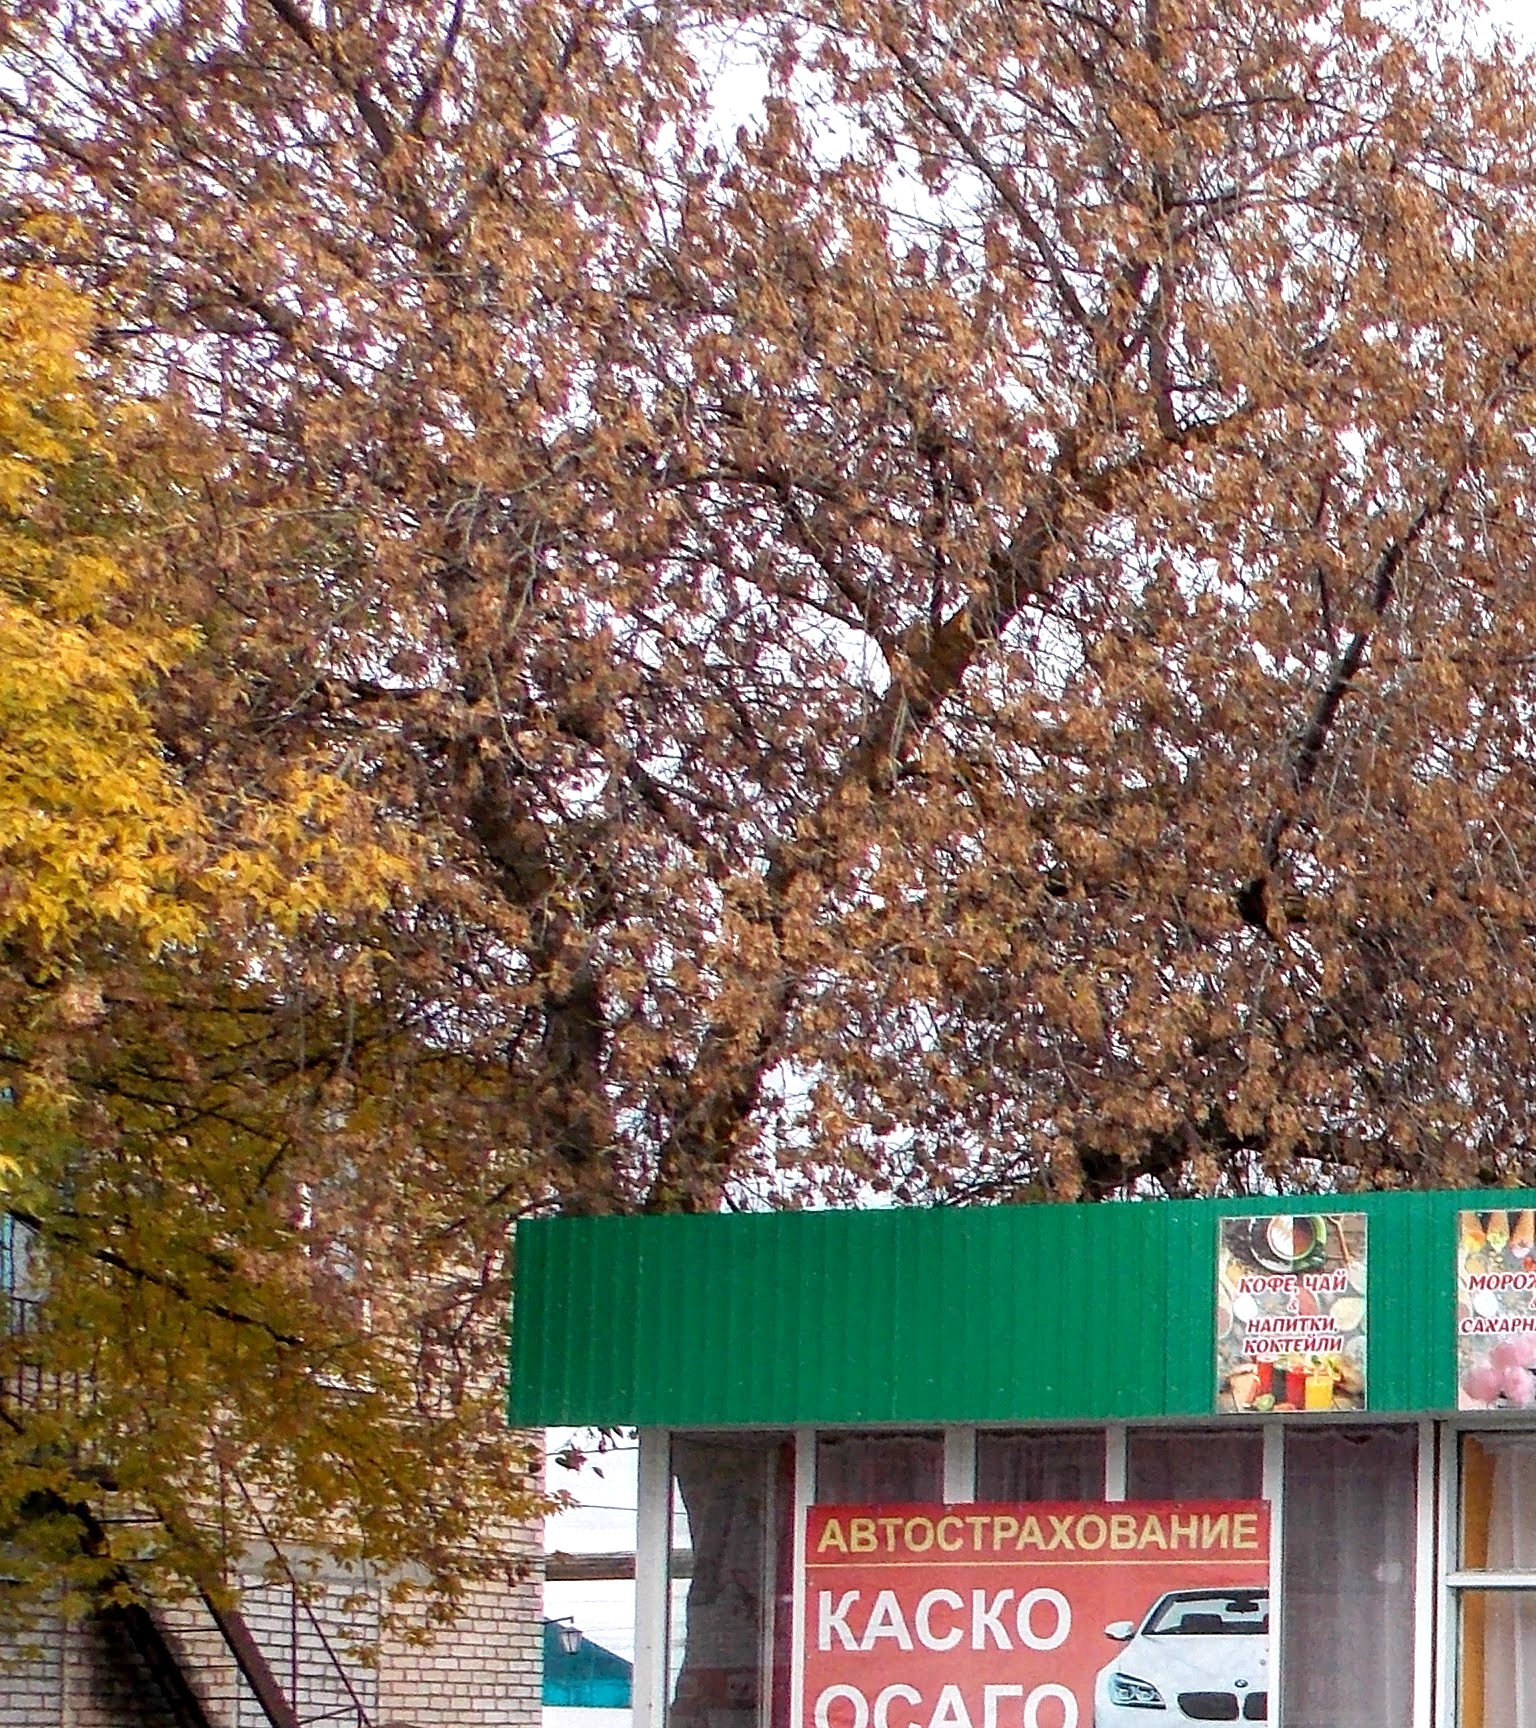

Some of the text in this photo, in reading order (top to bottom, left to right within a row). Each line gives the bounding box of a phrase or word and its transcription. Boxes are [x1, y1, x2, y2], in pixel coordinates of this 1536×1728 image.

[1239, 1269, 1347, 1293] КОФЕ, ЧАЙ
[1244, 1334, 1342, 1354] КОКТЕЙЛИ
[817, 1514, 1259, 1553] АВТОСТРАХОВАНИЕ
[818, 1587, 1072, 1651] КАСКО
